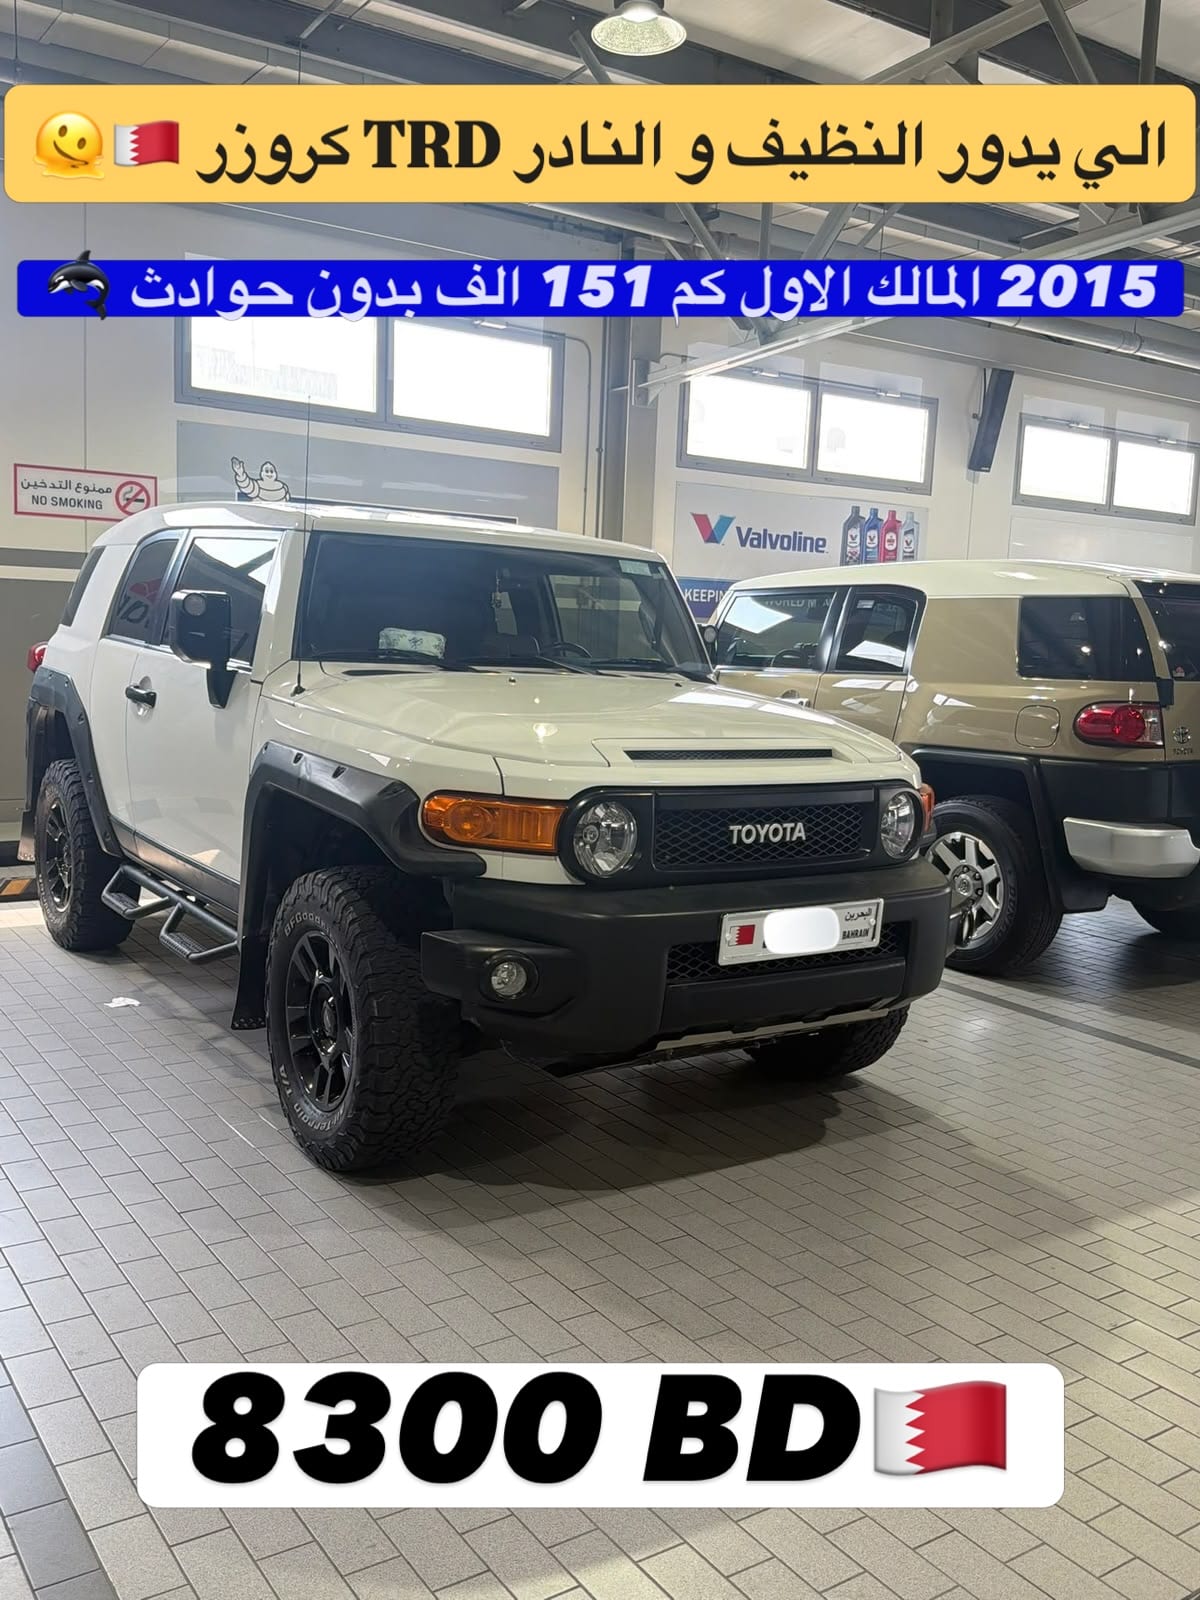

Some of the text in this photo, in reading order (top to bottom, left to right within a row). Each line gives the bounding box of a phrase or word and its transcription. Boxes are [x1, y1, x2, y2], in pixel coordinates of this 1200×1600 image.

[20, 478, 113, 495] ممنوع التدخين
[31, 494, 103, 510] NO SMOKING
[735, 526, 827, 554] Valvoline
[729, 822, 807, 845] TOYOTA
[842, 928, 870, 940] BAHRAIN
